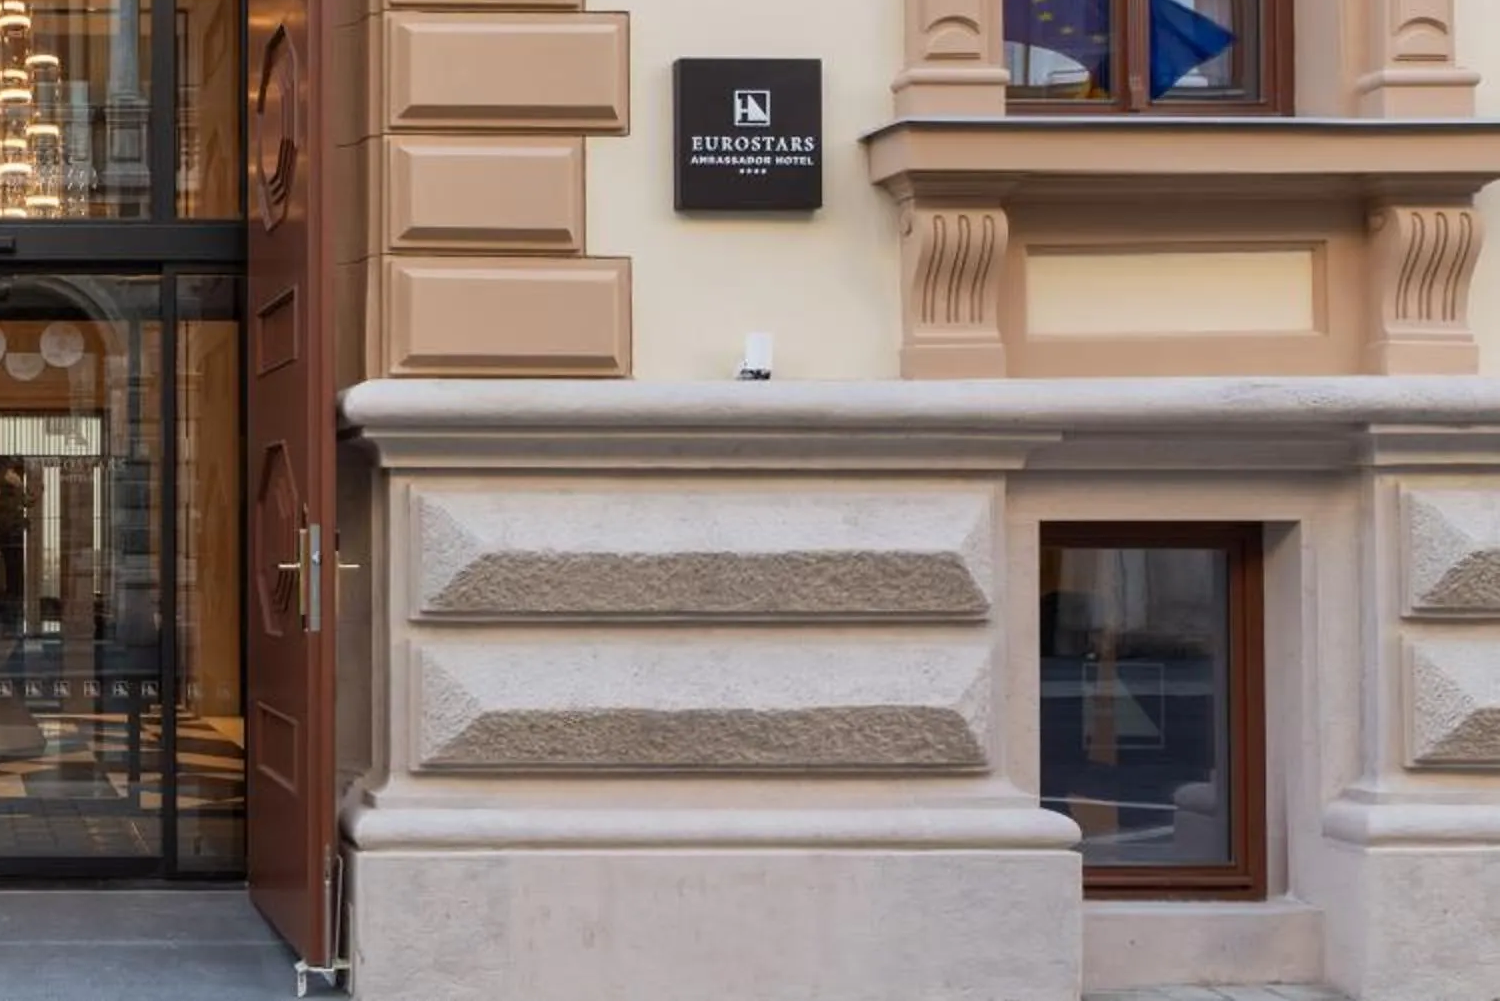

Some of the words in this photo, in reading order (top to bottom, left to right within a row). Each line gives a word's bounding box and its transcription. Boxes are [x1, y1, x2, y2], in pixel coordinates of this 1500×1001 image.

[691, 136, 815, 151] EUROSTARS
[690, 156, 771, 165] AMBASSADOR
[775, 156, 814, 165] HOTEL
